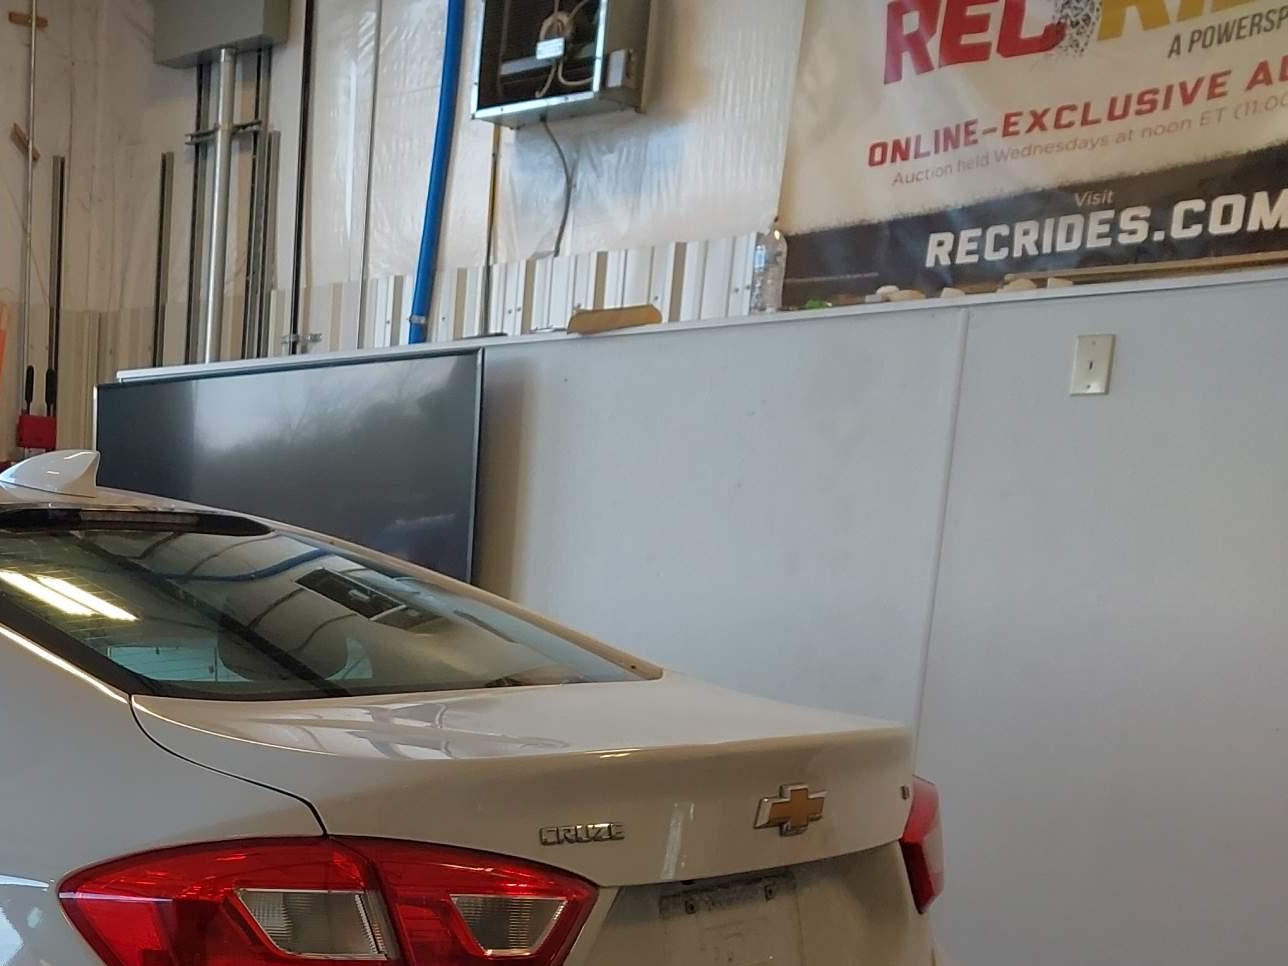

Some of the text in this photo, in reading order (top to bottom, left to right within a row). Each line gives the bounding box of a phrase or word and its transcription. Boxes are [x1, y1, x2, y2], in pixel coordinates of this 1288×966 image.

[1167, 33, 1182, 59] A
[867, 70, 1233, 167] ONLINE-EXCLUSIVE
[890, 163, 953, 187] Auction
[956, 151, 990, 172] held
[994, 134, 1110, 164] Wednesdays
[1114, 128, 1134, 145] at
[1141, 118, 1192, 139] noon
[1199, 107, 1229, 127] ET
[1074, 188, 1115, 208] Visit
[925, 188, 1288, 268] RECRIDES.COM
[538, 822, 625, 846] CRUZE
